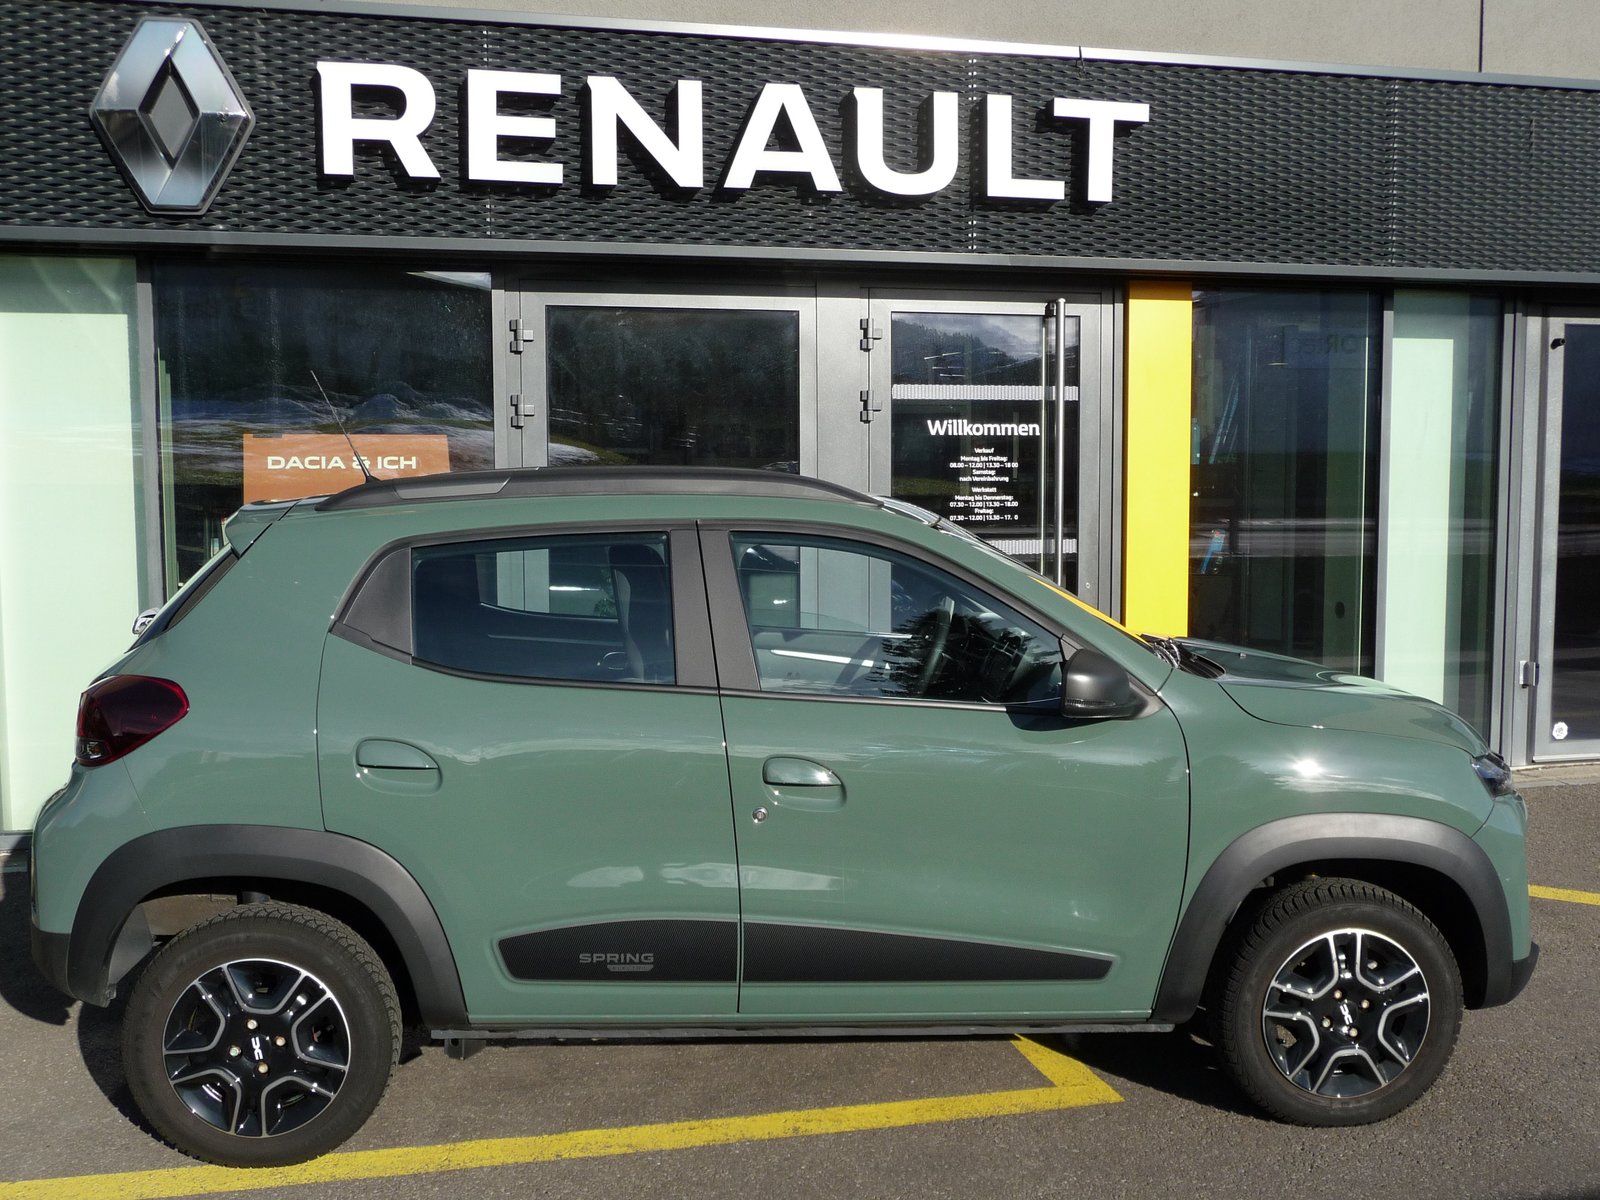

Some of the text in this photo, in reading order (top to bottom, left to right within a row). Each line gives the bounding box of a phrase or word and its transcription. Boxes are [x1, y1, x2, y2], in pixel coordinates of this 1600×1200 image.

[315, 59, 1150, 204] RENAULT
[926, 418, 1041, 437] Willkommen
[267, 455, 346, 470] DACIA
[377, 455, 417, 470] ICH
[579, 953, 654, 963] SPRING
